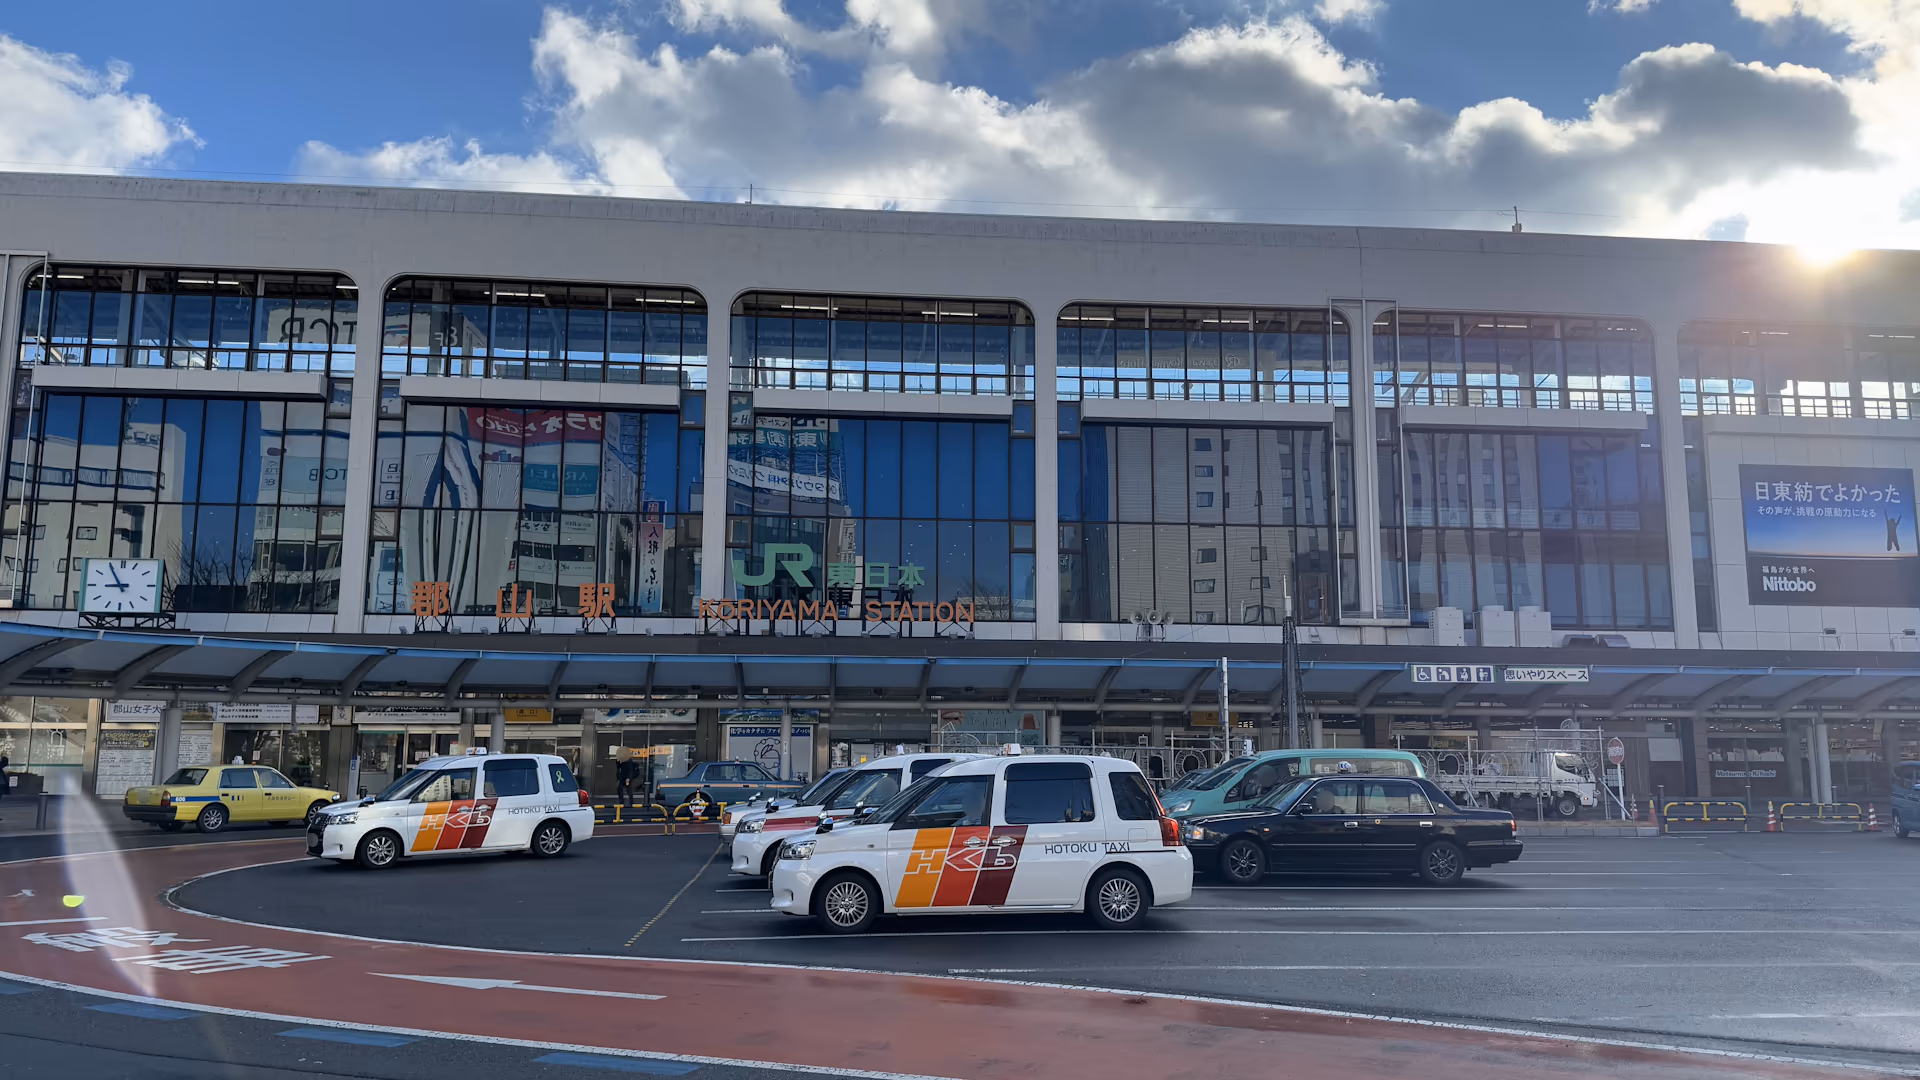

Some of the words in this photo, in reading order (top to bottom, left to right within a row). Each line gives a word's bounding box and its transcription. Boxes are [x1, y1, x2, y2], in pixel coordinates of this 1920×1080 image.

[1755, 481, 1901, 504] 日東紡でよかった
[1757, 506, 1877, 518] その声が、挑戦の原動力になる
[733, 543, 814, 588] JR
[827, 562, 925, 589] 東日本
[1762, 565, 1816, 574] 福島から世界へ
[1762, 576, 1817, 593] Nittobo
[411, 581, 616, 618] 郡山駅
[864, 601, 975, 623] STATION
[1505, 669, 1589, 681] 思いやりスペース
[113, 704, 166, 714] 郡山女子大
[508, 806, 541, 815] HOTOKU
[543, 804, 561, 814] TAXI
[1044, 842, 1098, 855] HOTOKU
[1101, 841, 1131, 853] TAXI
